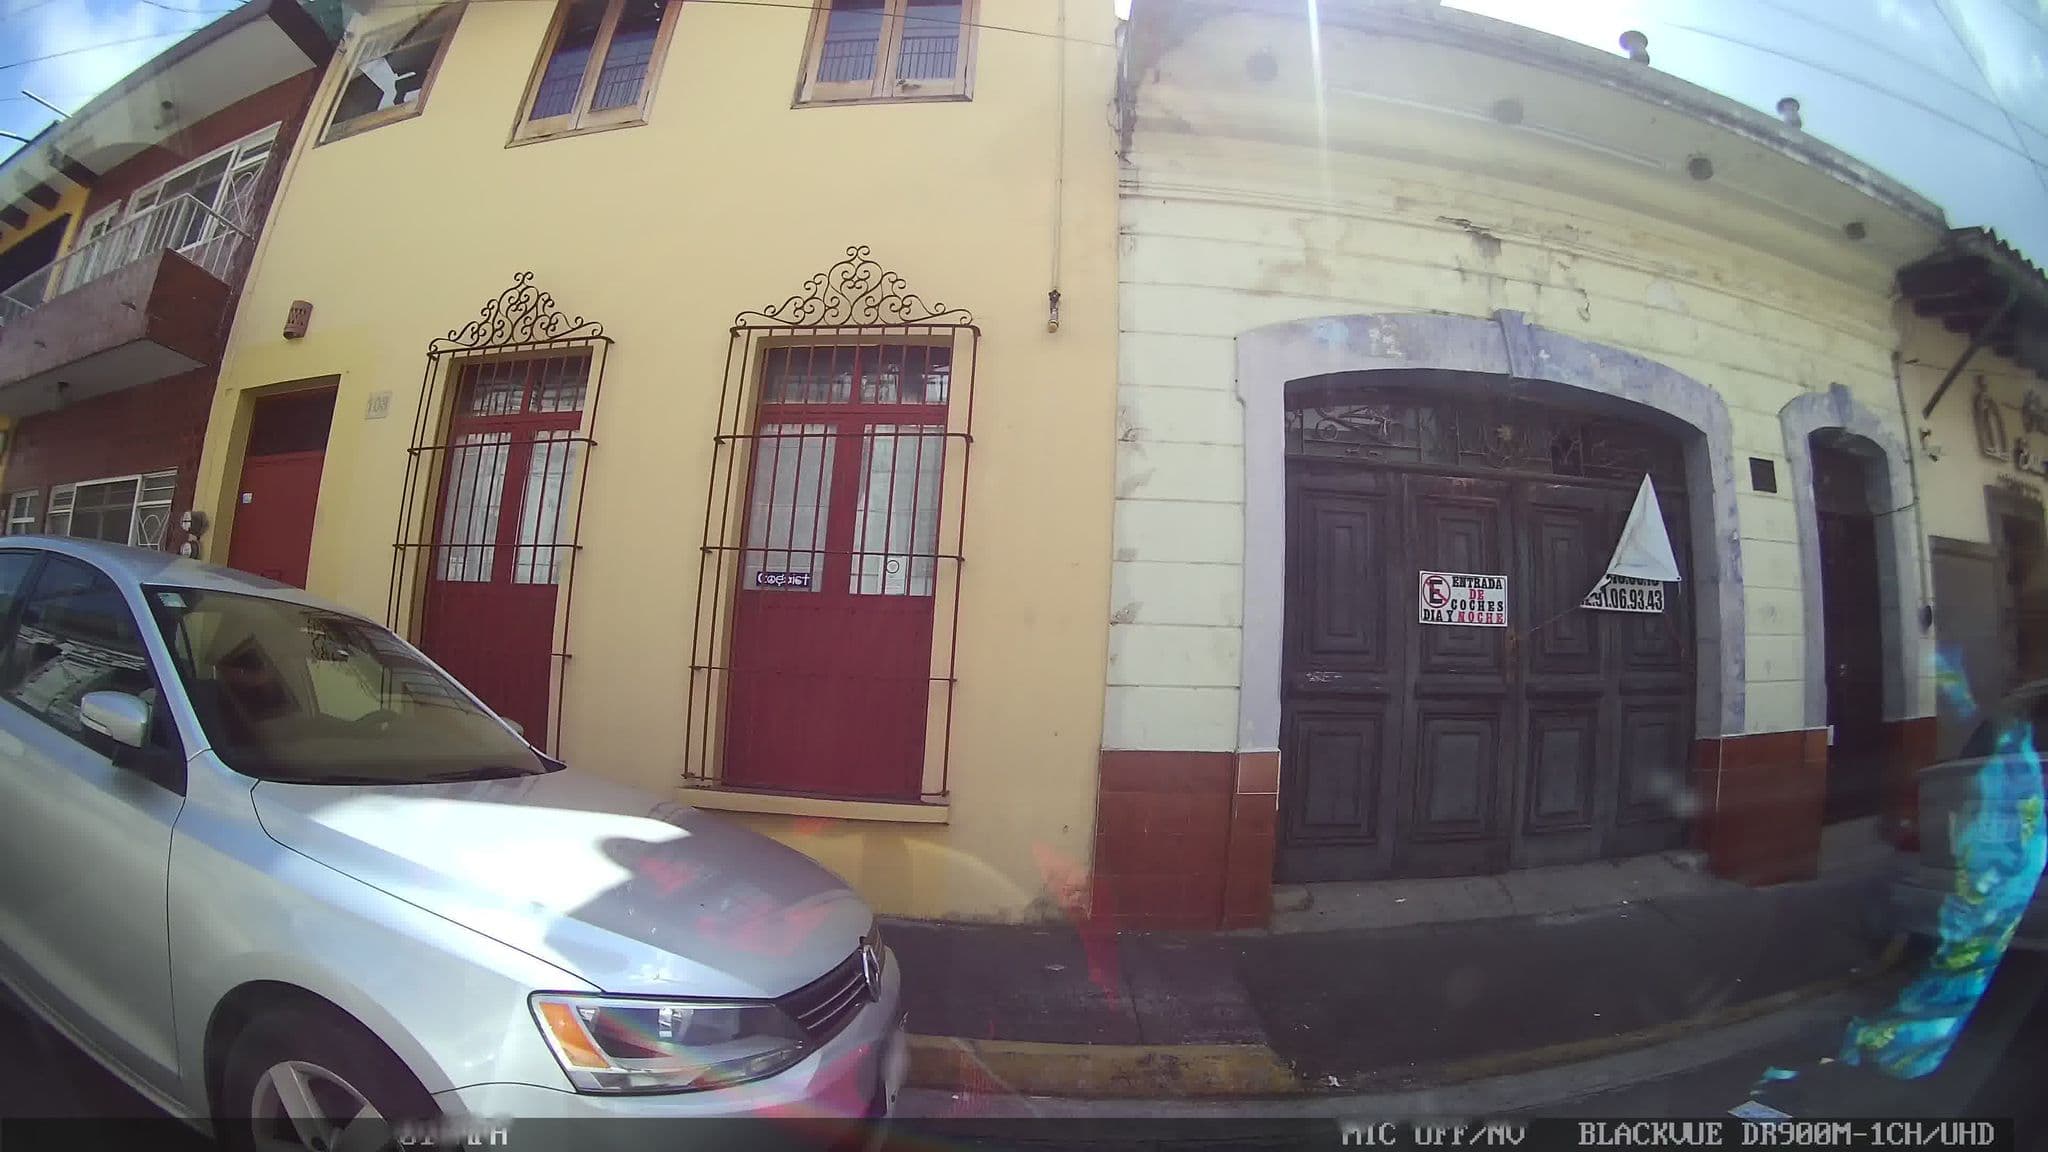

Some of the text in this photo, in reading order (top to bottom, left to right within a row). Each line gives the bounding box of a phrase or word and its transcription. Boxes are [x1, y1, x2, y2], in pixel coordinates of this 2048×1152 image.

[1452, 576, 1503, 589] ENTRADA
[1469, 589, 1485, 600] DE
[1451, 599, 1504, 612] COCHES
[1423, 609, 1504, 624] DIA Y NOCHE
